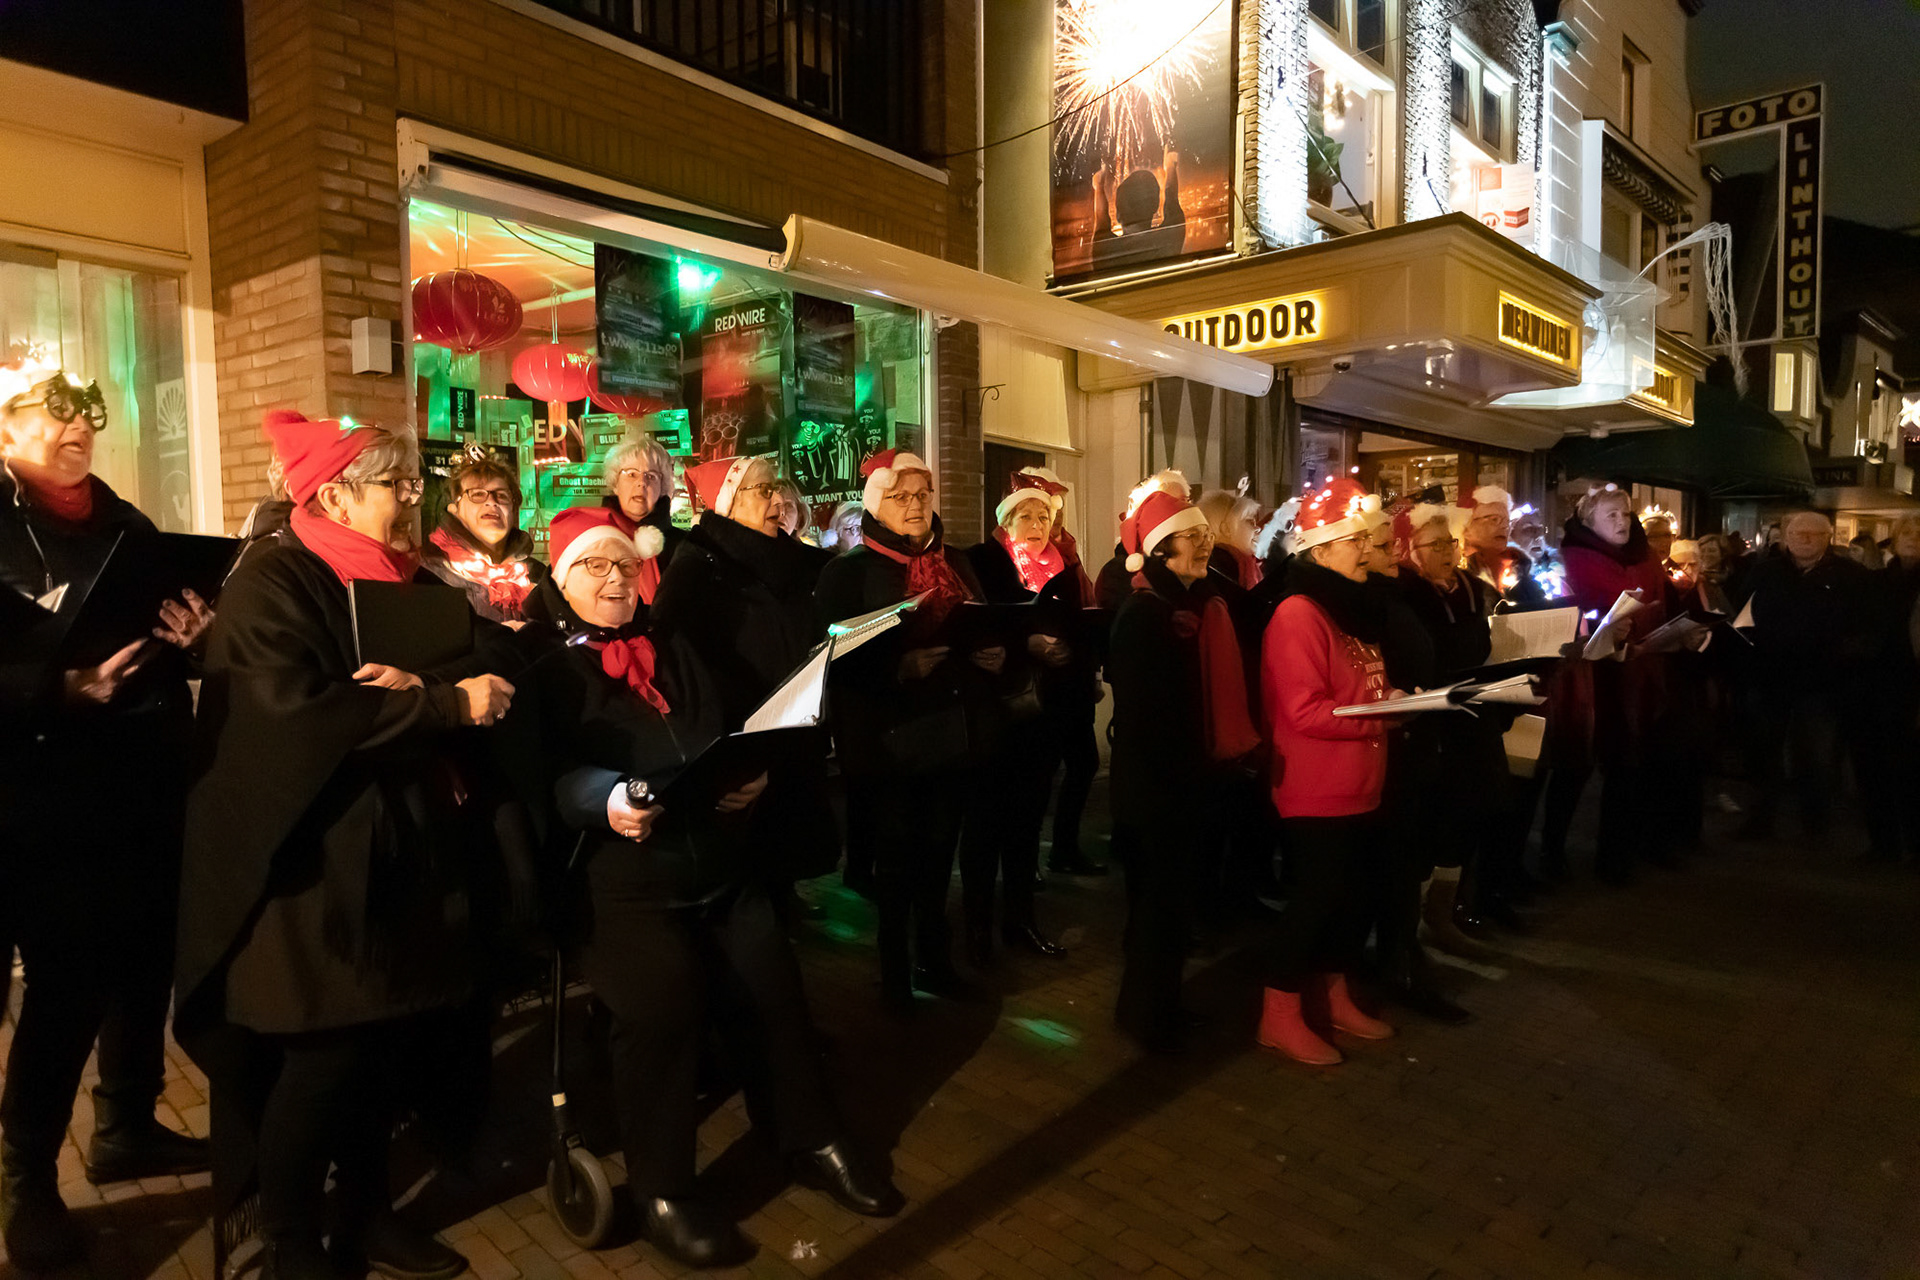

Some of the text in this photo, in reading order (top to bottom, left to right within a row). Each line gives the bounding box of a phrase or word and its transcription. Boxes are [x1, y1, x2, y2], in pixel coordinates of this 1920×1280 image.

[1702, 90, 1816, 138] FOTO
[1788, 131, 1814, 336] LINTHOUT
[600, 434, 618, 444] BLUE
[559, 477, 581, 486] Ghost
[815, 492, 843, 504] WANT
